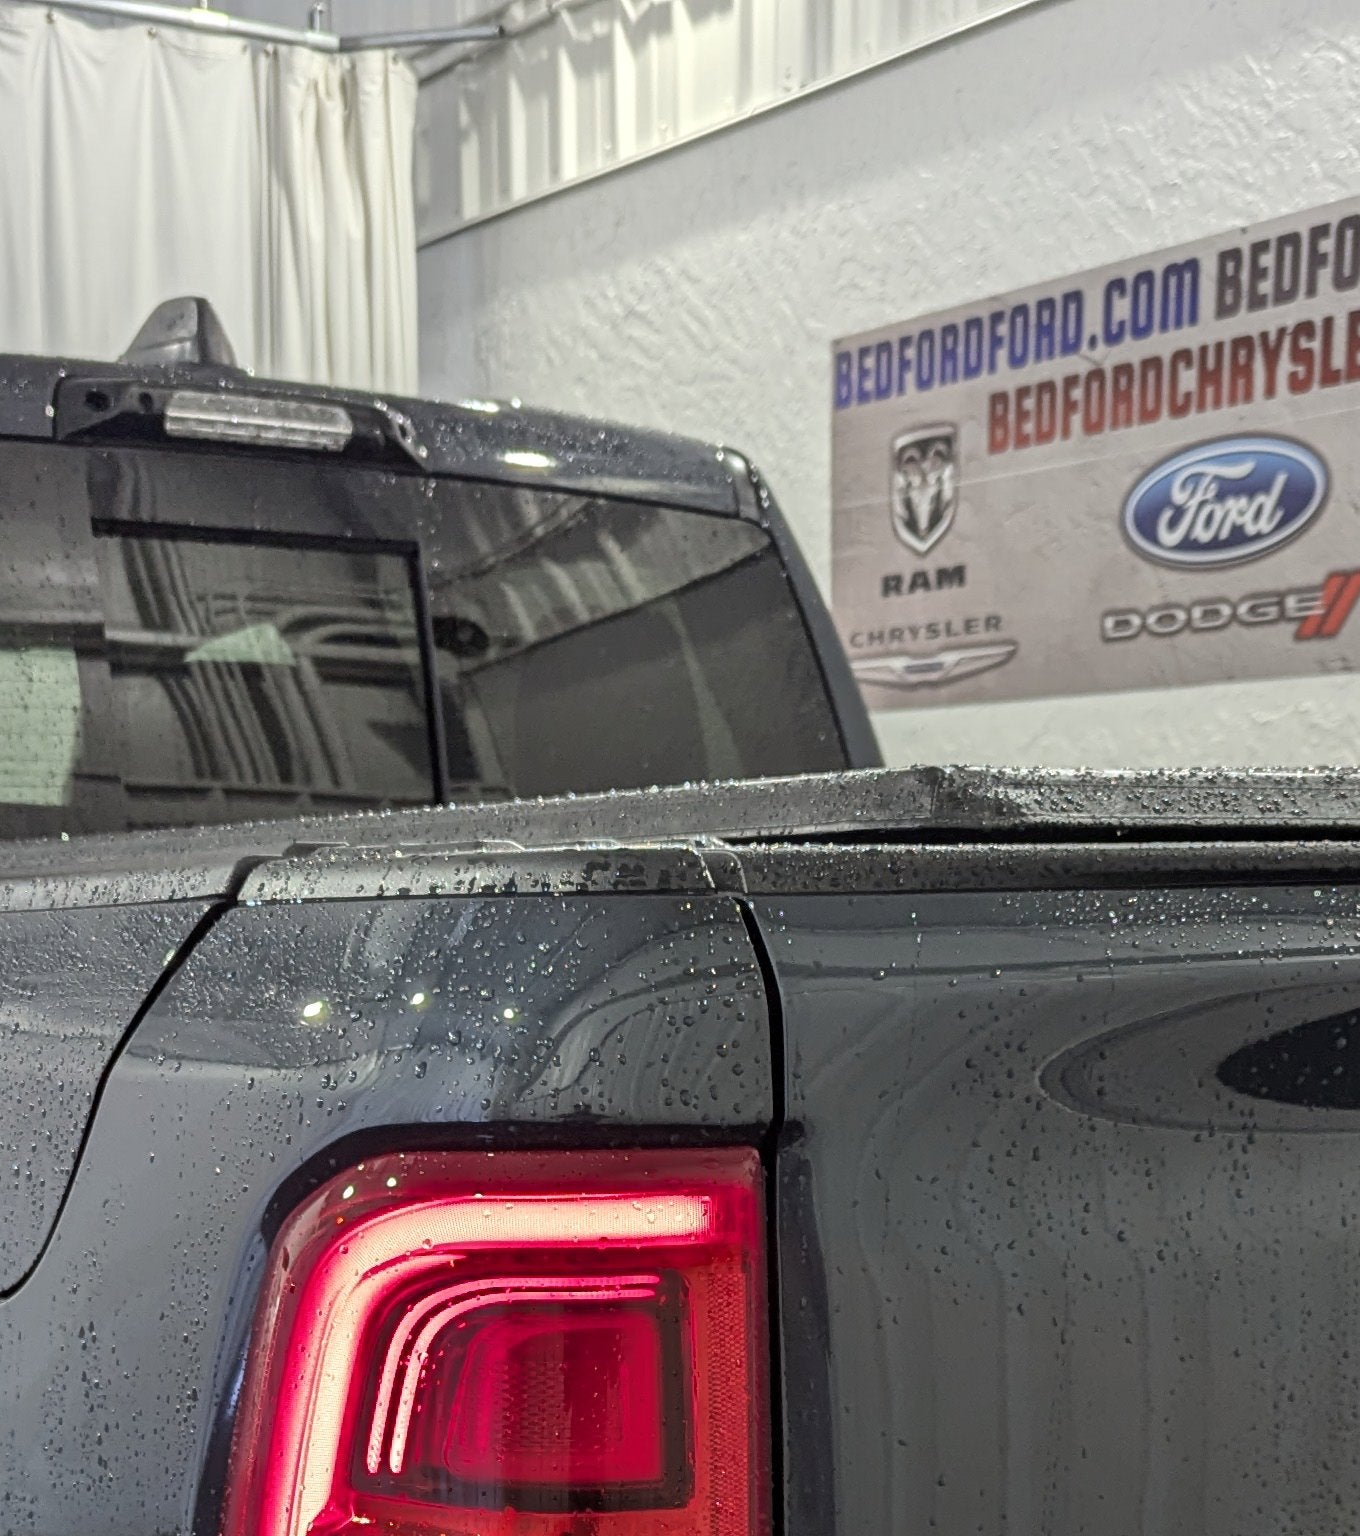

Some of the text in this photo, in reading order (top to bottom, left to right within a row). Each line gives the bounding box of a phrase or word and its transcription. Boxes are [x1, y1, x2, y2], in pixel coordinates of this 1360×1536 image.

[836, 257, 1200, 410] BEDFORDFORD.COM
[1156, 460, 1289, 549] Ford
[881, 565, 966, 598] RAM
[849, 615, 1002, 648] CHRYSLER
[1100, 588, 1327, 643] DODGE
